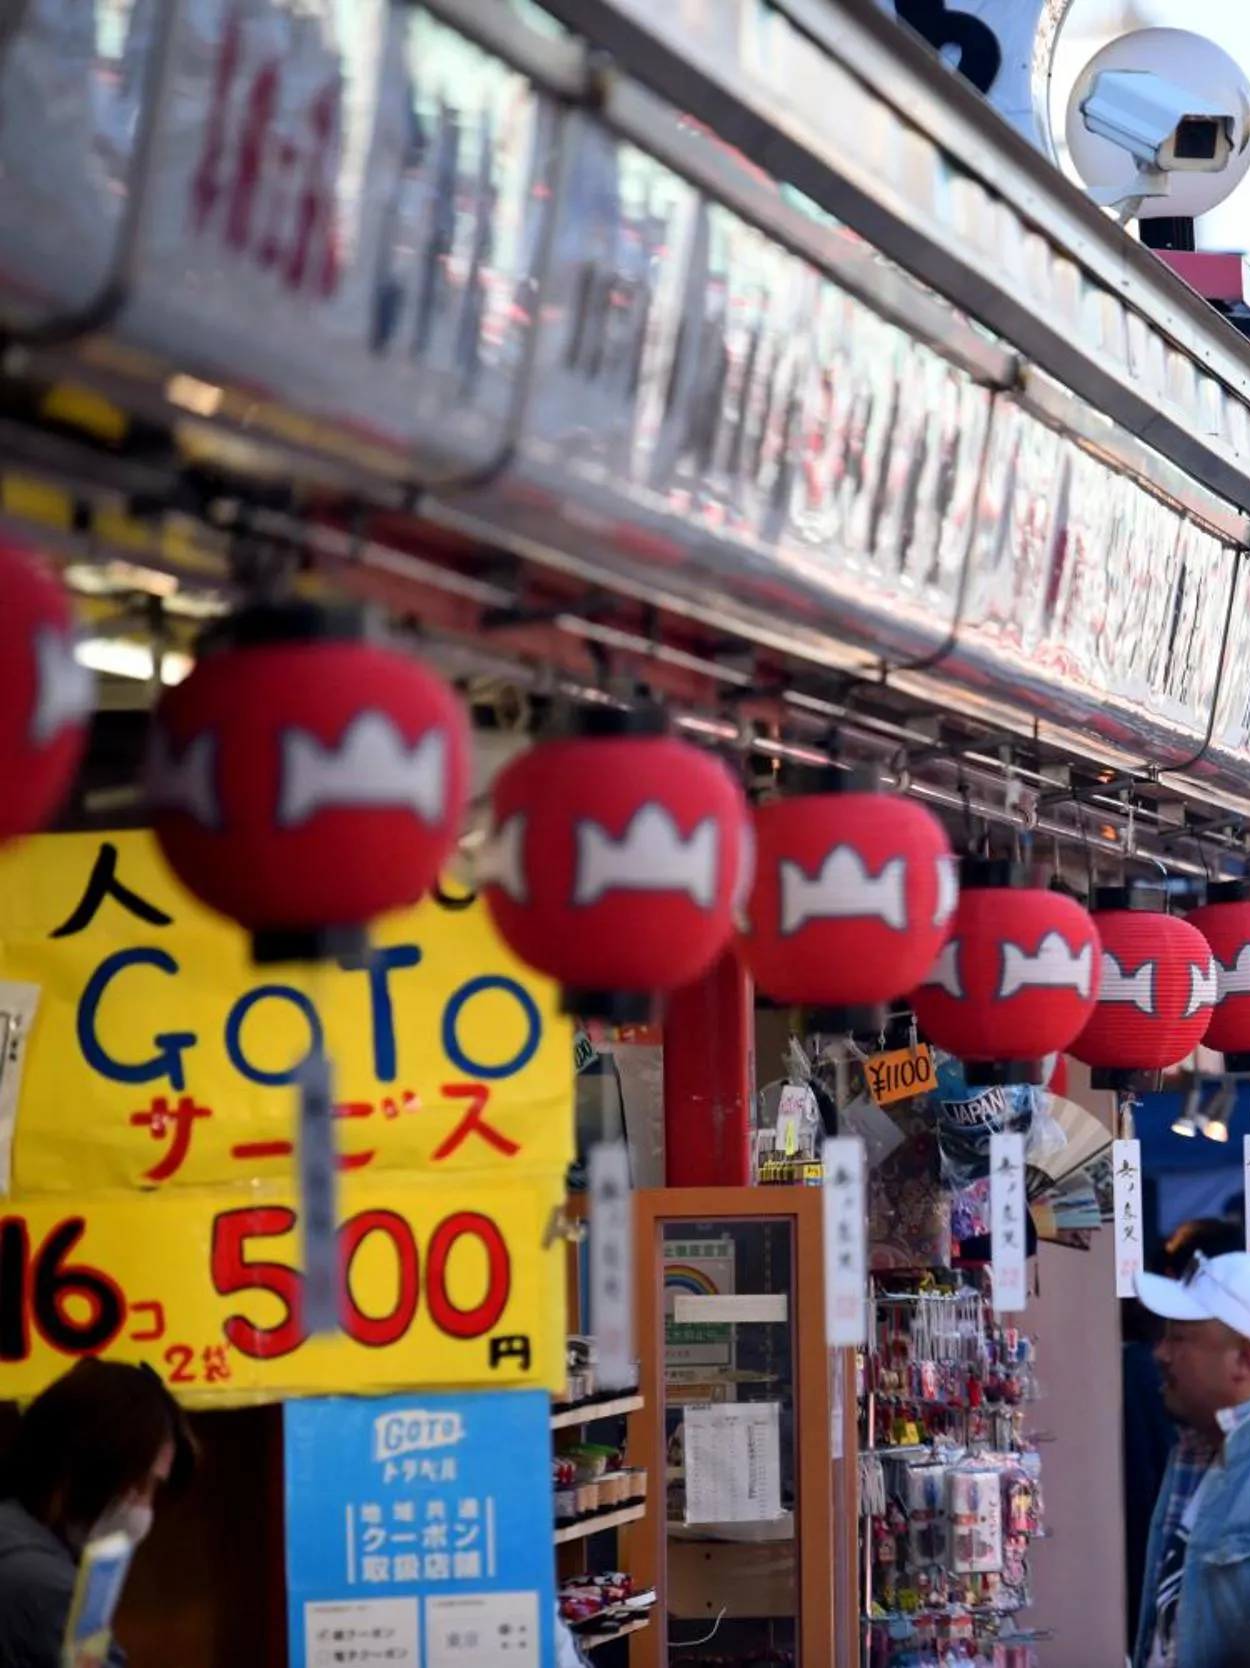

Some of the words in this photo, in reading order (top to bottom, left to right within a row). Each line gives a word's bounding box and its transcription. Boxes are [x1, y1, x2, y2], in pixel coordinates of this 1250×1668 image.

[869, 1054, 930, 1101] ¥1100
[952, 1087, 1006, 1125] JAPAN
[130, 1083, 522, 1182] サービス
[362, 1523, 481, 1553] クーポン
